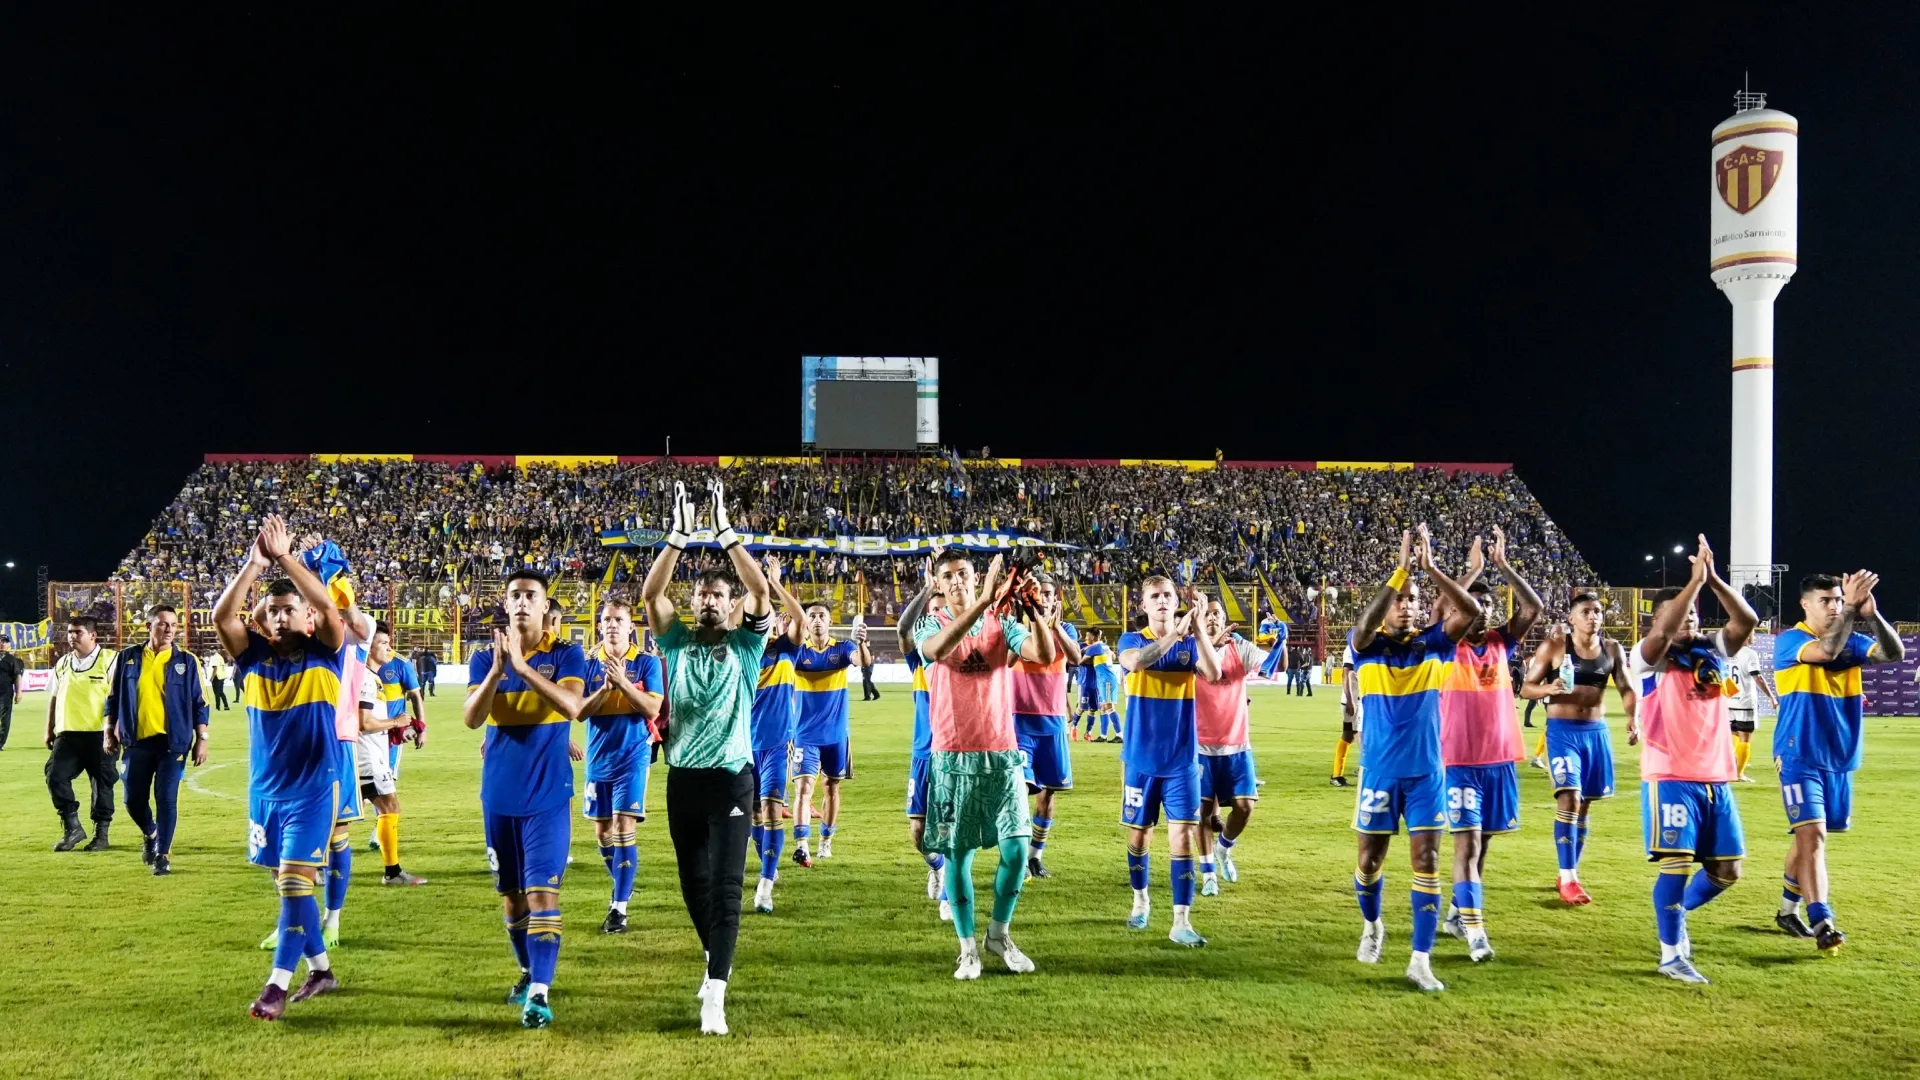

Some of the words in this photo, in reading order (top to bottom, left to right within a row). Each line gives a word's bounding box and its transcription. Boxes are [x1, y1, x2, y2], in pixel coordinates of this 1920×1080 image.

[0, 621, 54, 649] ARELA
[1552, 756, 1574, 774] 21
[1124, 785, 1144, 808] 15
[1360, 787, 1391, 813] 22
[1783, 783, 1804, 806] 11
[1661, 803, 1689, 828] 18
